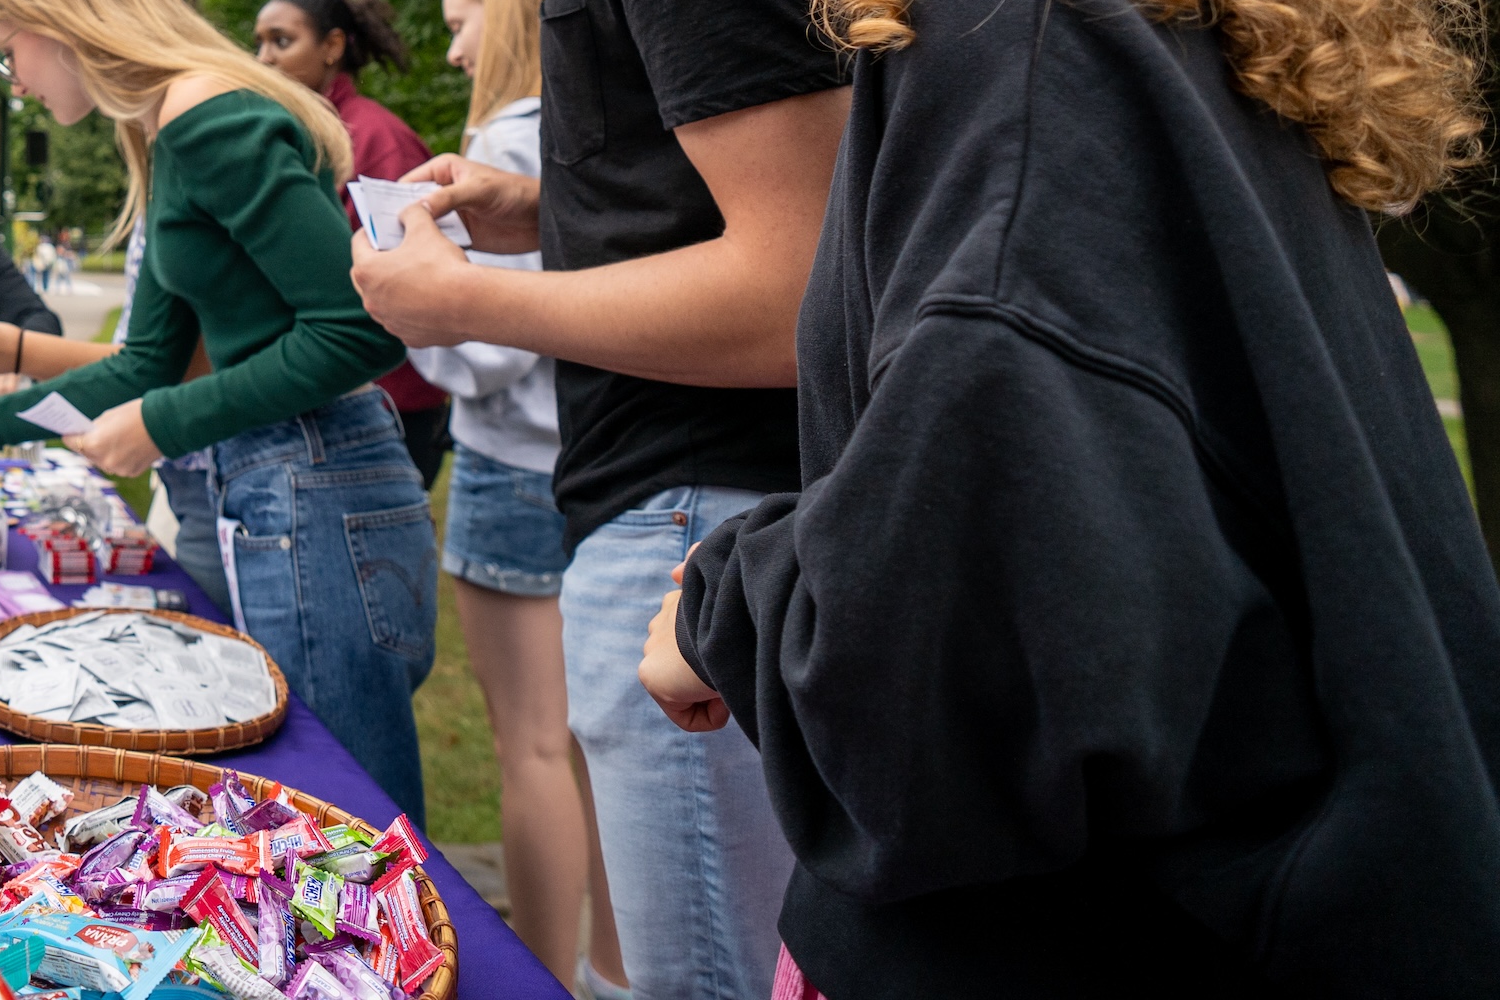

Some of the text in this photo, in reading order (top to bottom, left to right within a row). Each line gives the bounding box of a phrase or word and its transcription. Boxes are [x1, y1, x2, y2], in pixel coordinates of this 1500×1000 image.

[217, 905, 230, 922] Candy
[218, 916, 253, 963] Immensely Fruity
[229, 921, 244, 941] Chewy
[281, 907, 296, 968] HI-CHEW
[399, 933, 409, 951] Candy
[368, 978, 384, 995] GRAPE
